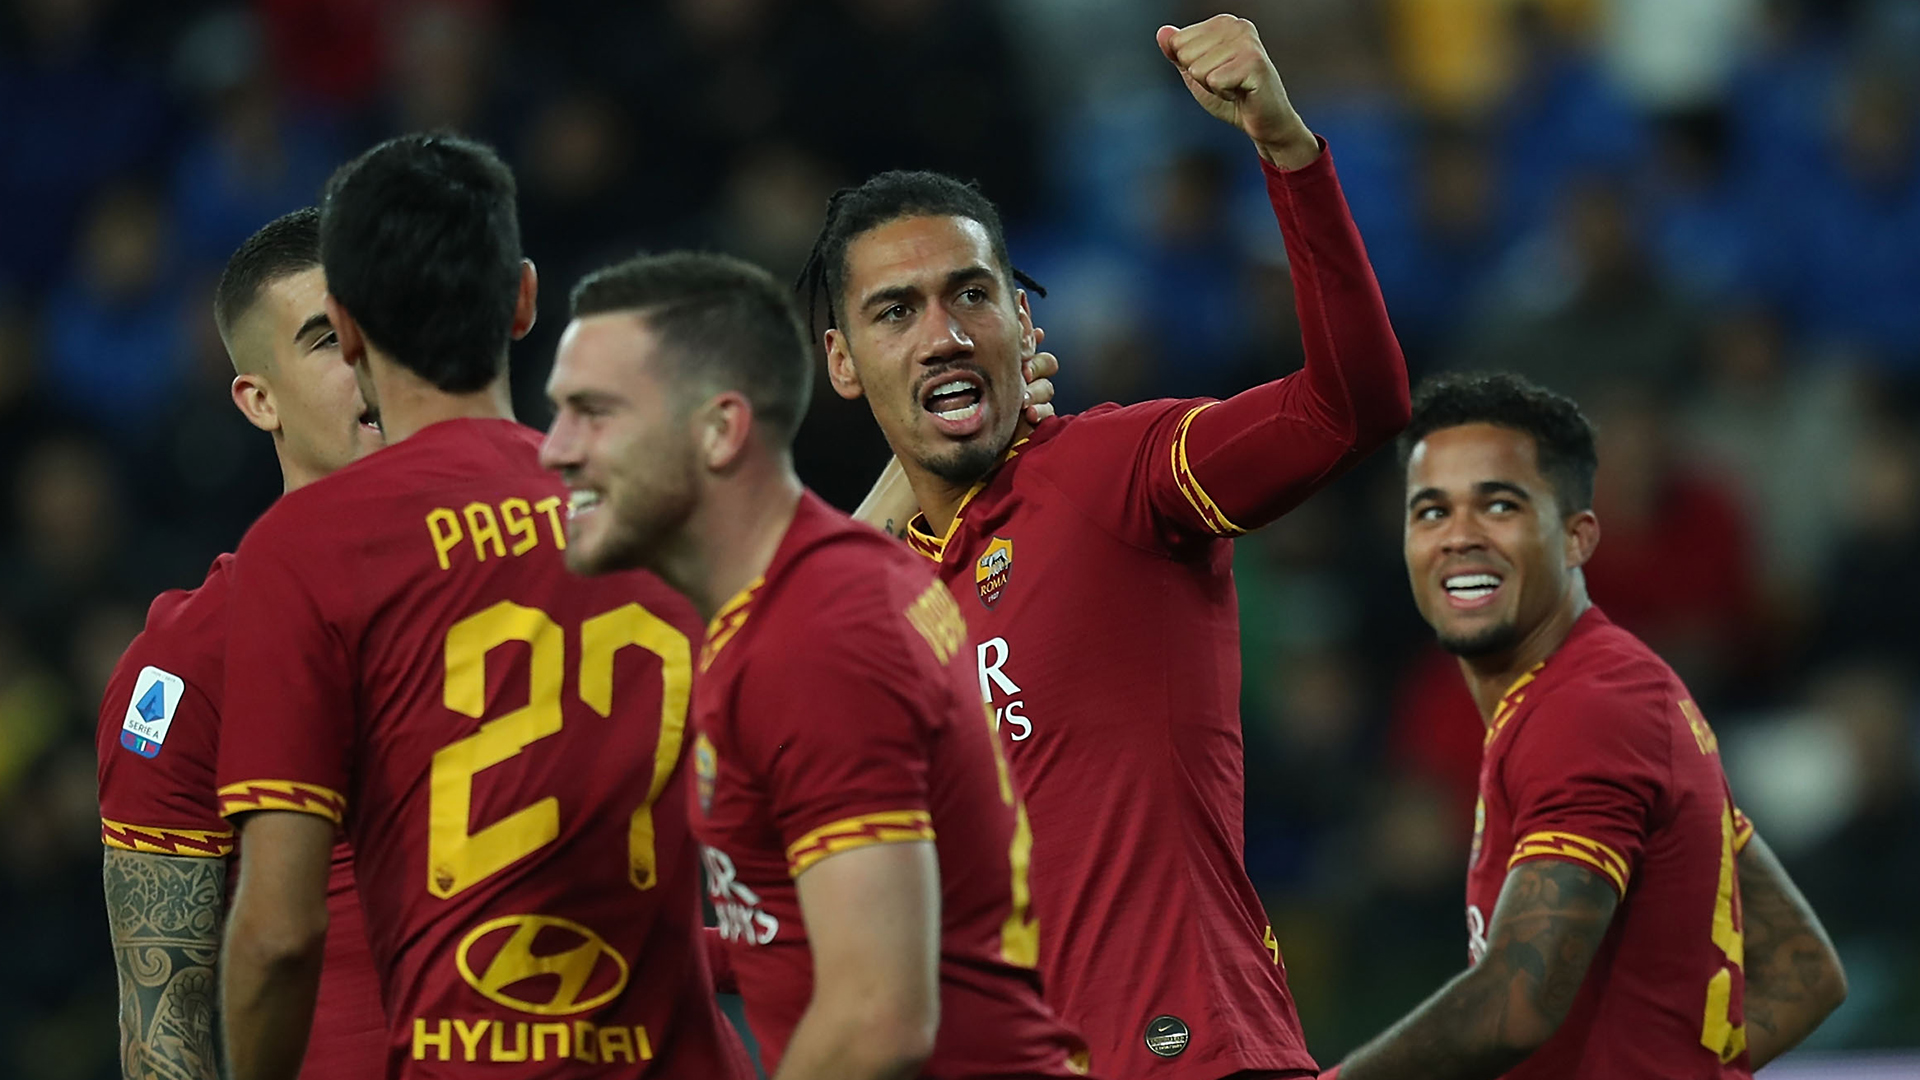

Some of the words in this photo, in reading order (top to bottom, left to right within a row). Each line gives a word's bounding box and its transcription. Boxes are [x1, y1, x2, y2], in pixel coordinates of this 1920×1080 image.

[426, 496, 574, 570] PAST
[980, 573, 1007, 597] ROMA
[128, 720, 152, 736] SERIE
[152, 730, 160, 740] A
[428, 600, 692, 899] 27
[412, 1018, 653, 1064] HYUNDAI
